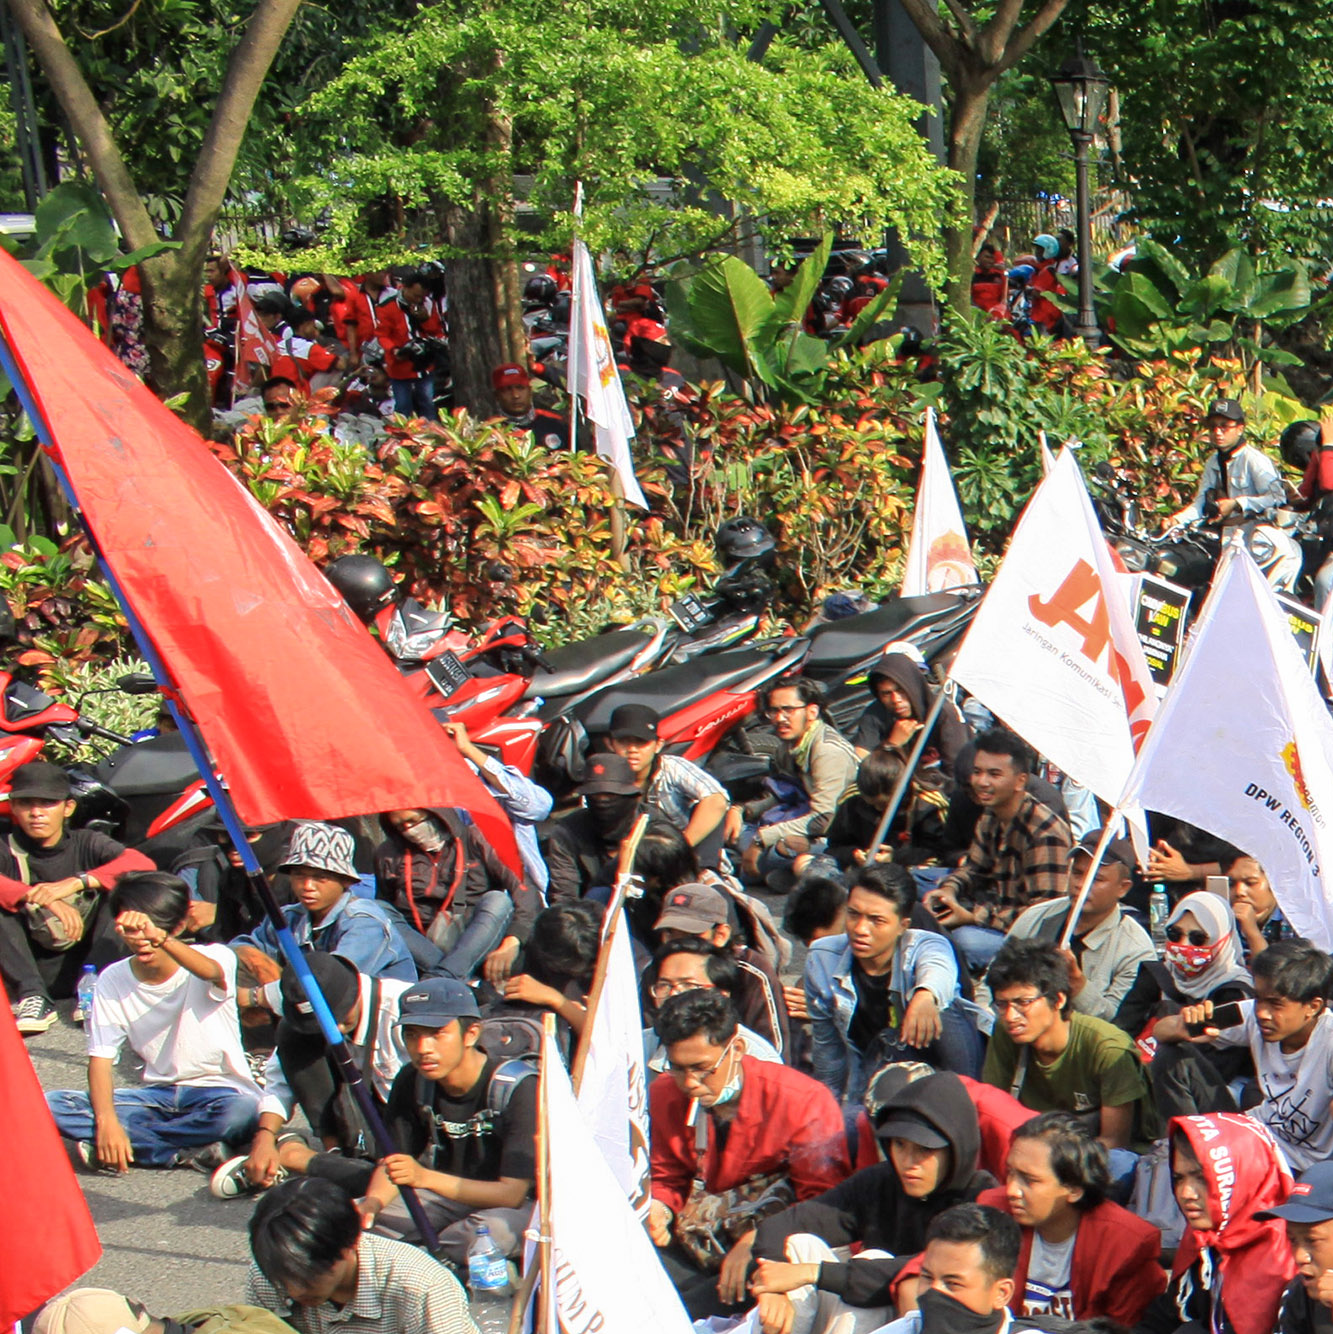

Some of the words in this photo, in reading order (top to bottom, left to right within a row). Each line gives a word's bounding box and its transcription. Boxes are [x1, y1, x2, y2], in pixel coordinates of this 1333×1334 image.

[1244, 783, 1282, 811] DPW
[1280, 810, 1315, 864] REGION
[1312, 865, 1321, 878] 3
